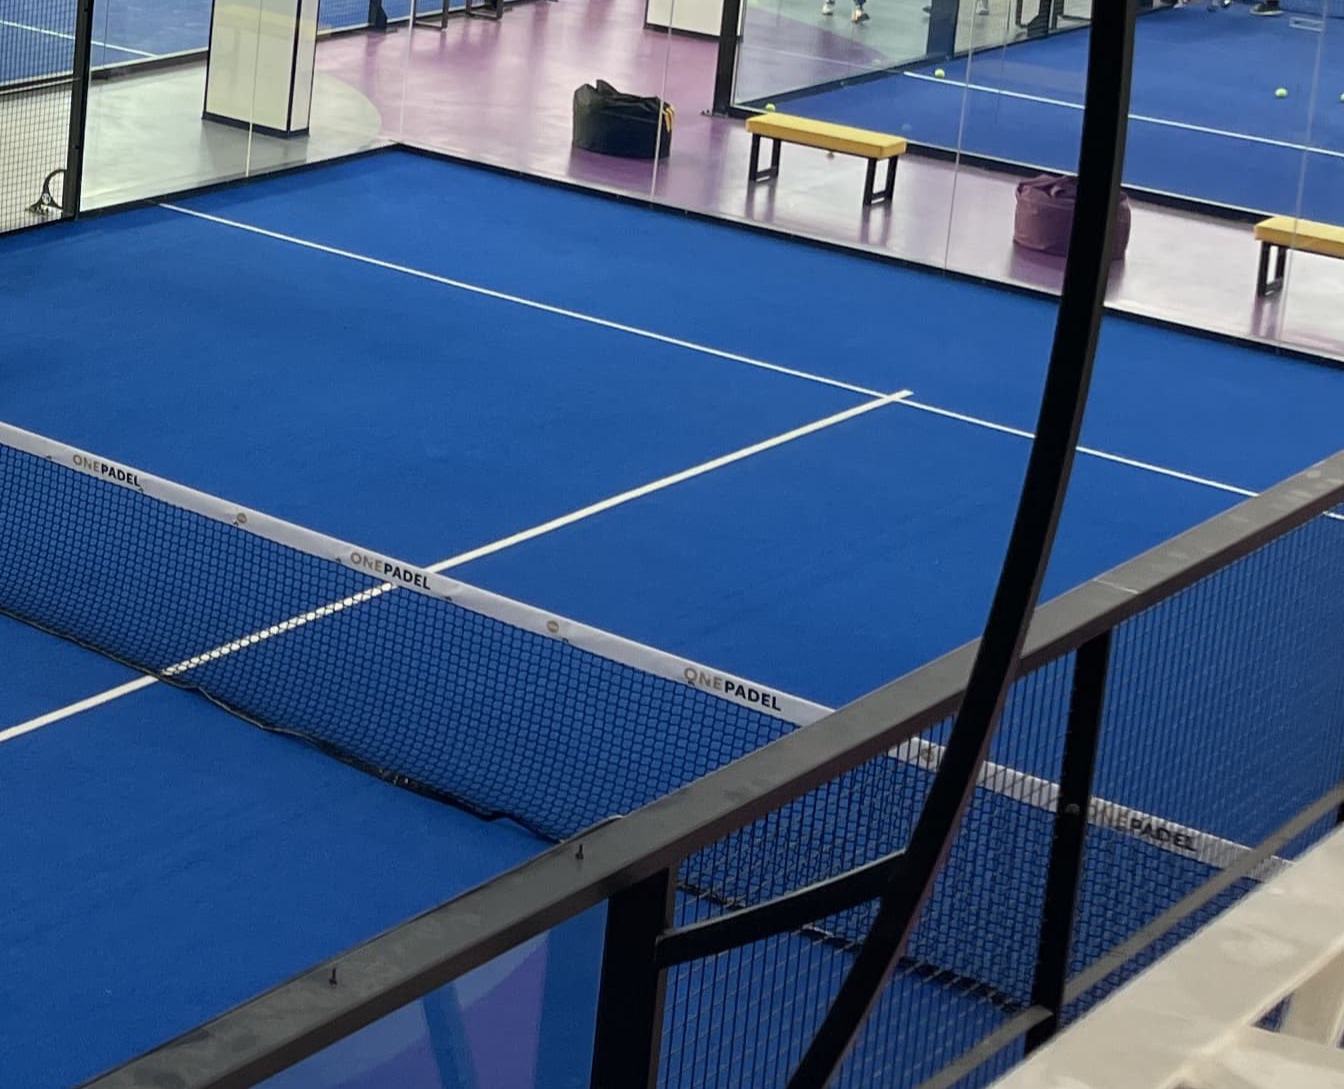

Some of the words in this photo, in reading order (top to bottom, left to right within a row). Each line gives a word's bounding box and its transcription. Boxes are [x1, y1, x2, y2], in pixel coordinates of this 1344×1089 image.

[72, 453, 141, 488] ONEPADEL
[350, 552, 431, 591] ONEPADEL
[683, 667, 782, 712] ONEPADEL
